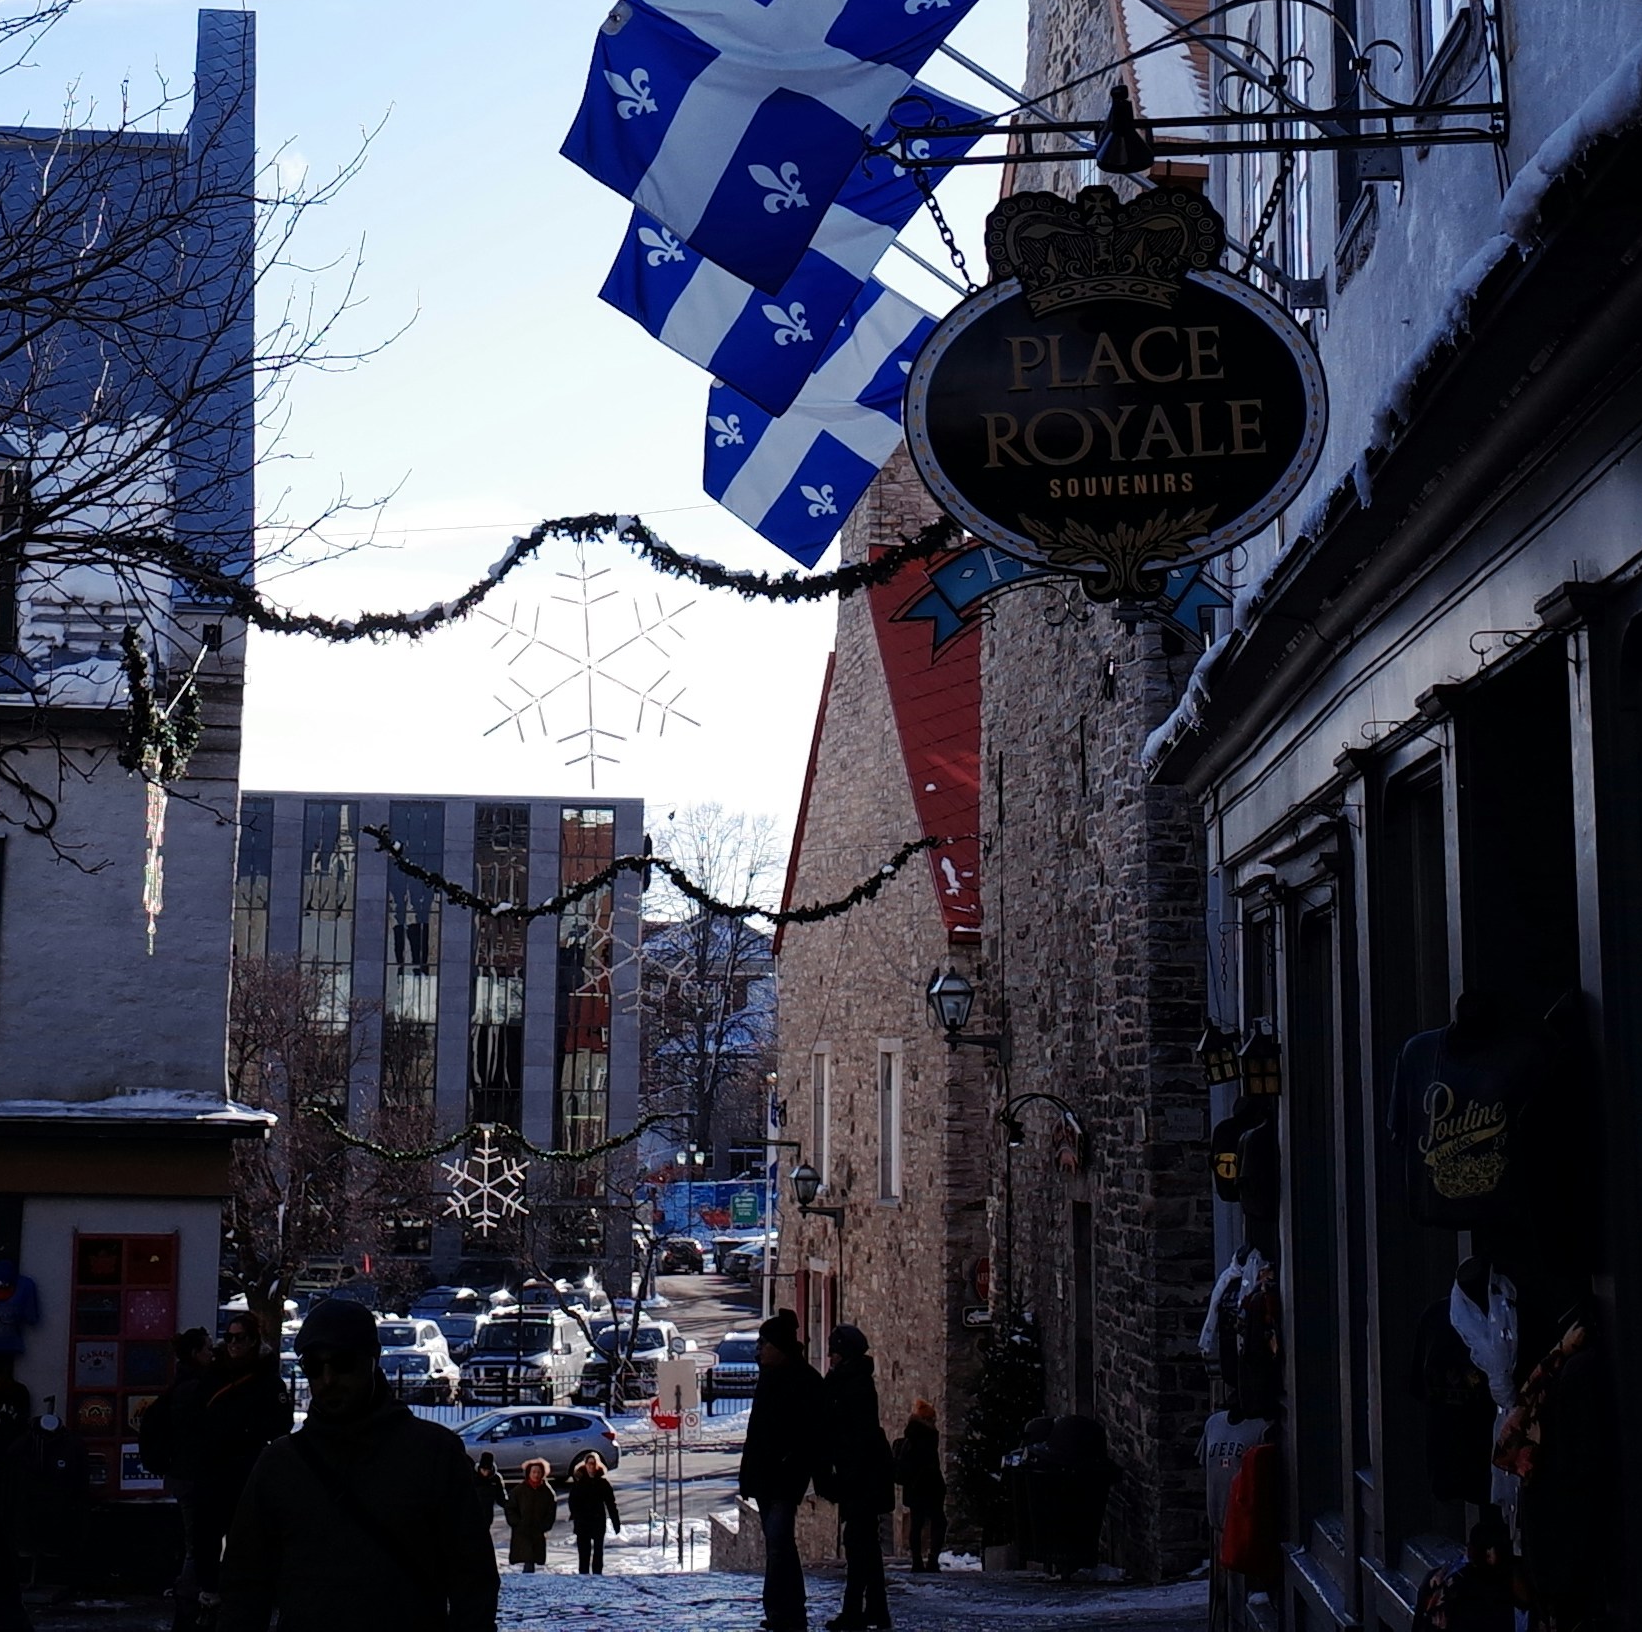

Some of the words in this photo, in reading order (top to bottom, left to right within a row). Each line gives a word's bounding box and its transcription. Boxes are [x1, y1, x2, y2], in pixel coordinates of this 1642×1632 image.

[1005, 325, 1225, 392] PLACE
[980, 399, 1267, 468] ROYALE
[1049, 472, 1194, 498] SOUVENIRS
[1418, 1081, 1506, 1153] Poutine
